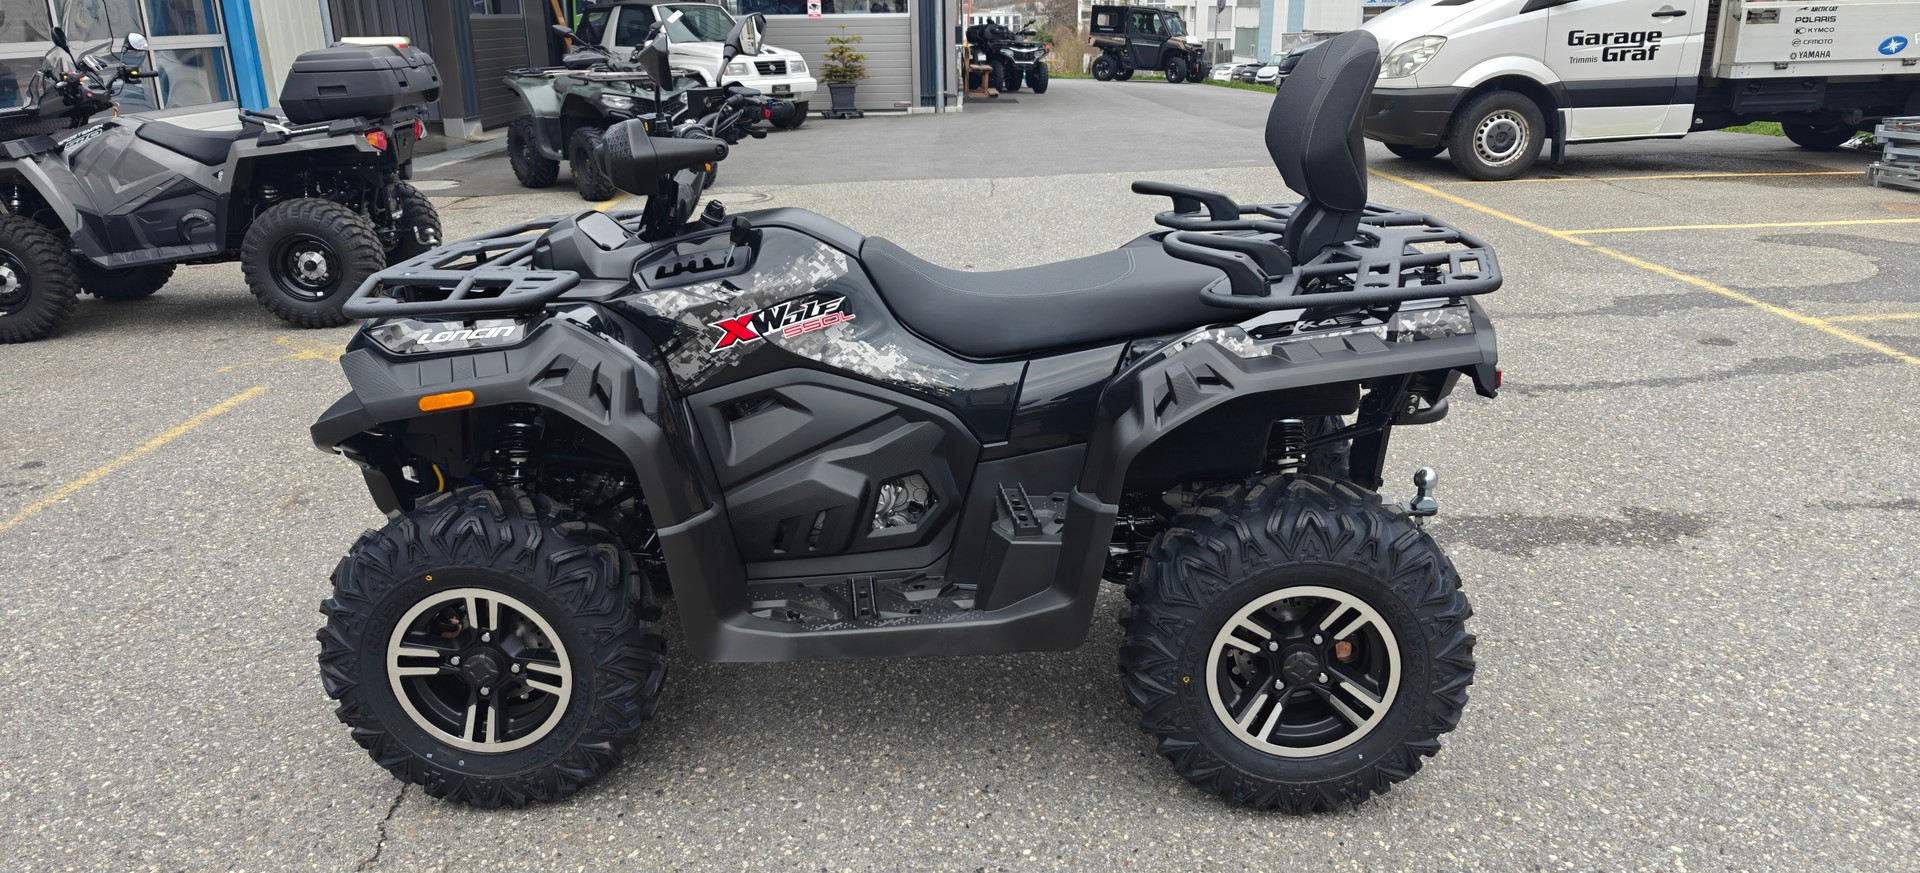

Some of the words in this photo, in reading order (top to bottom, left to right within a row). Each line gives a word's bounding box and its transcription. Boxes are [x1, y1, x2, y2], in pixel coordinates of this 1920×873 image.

[1567, 30, 1662, 48] Garage
[1569, 56, 1598, 64] Trimmis
[1602, 45, 1661, 62] Graf
[1799, 51, 1831, 59] YAMAHA
[783, 311, 856, 339] 550L
